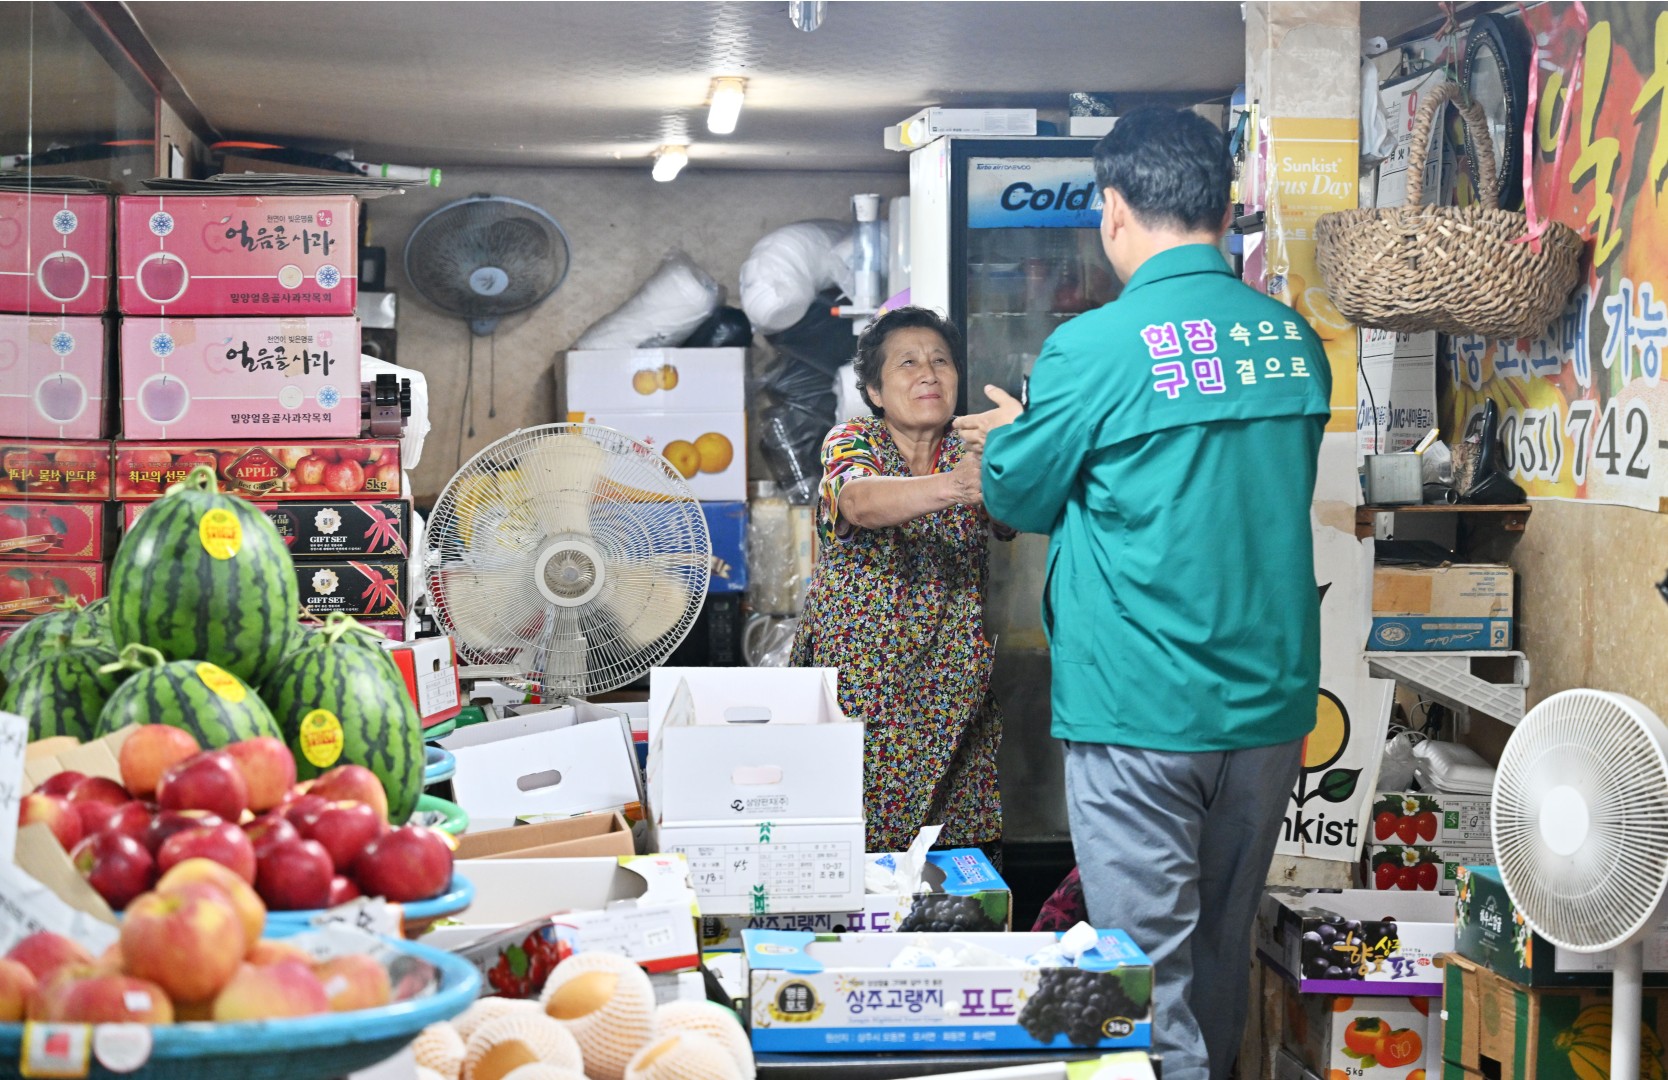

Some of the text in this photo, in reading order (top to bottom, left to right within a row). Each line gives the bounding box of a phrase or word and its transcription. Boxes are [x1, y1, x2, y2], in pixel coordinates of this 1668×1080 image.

[1282, 157, 1339, 173] Sunkist
[1311, 174, 1353, 200] Day
[1000, 181, 1096, 211] Cold
[230, 292, 332, 304] 밀양얼음골사과작목회
[1141, 320, 1303, 359] 현장 속으로
[1605, 287, 1668, 379] 가능
[1152, 357, 1311, 399] 구민 곁으로
[230, 413, 332, 424] 밀양얼음골사과작목회
[128, 470, 161, 483] 최고의
[235, 466, 279, 478] APPLE
[366, 479, 388, 490] 5kg
[307, 596, 328, 604] GIFT
[1282, 810, 1359, 848] nkist
[846, 988, 1016, 1017] 상주고랭지 포도
[1107, 1022, 1130, 1034] 3kg
